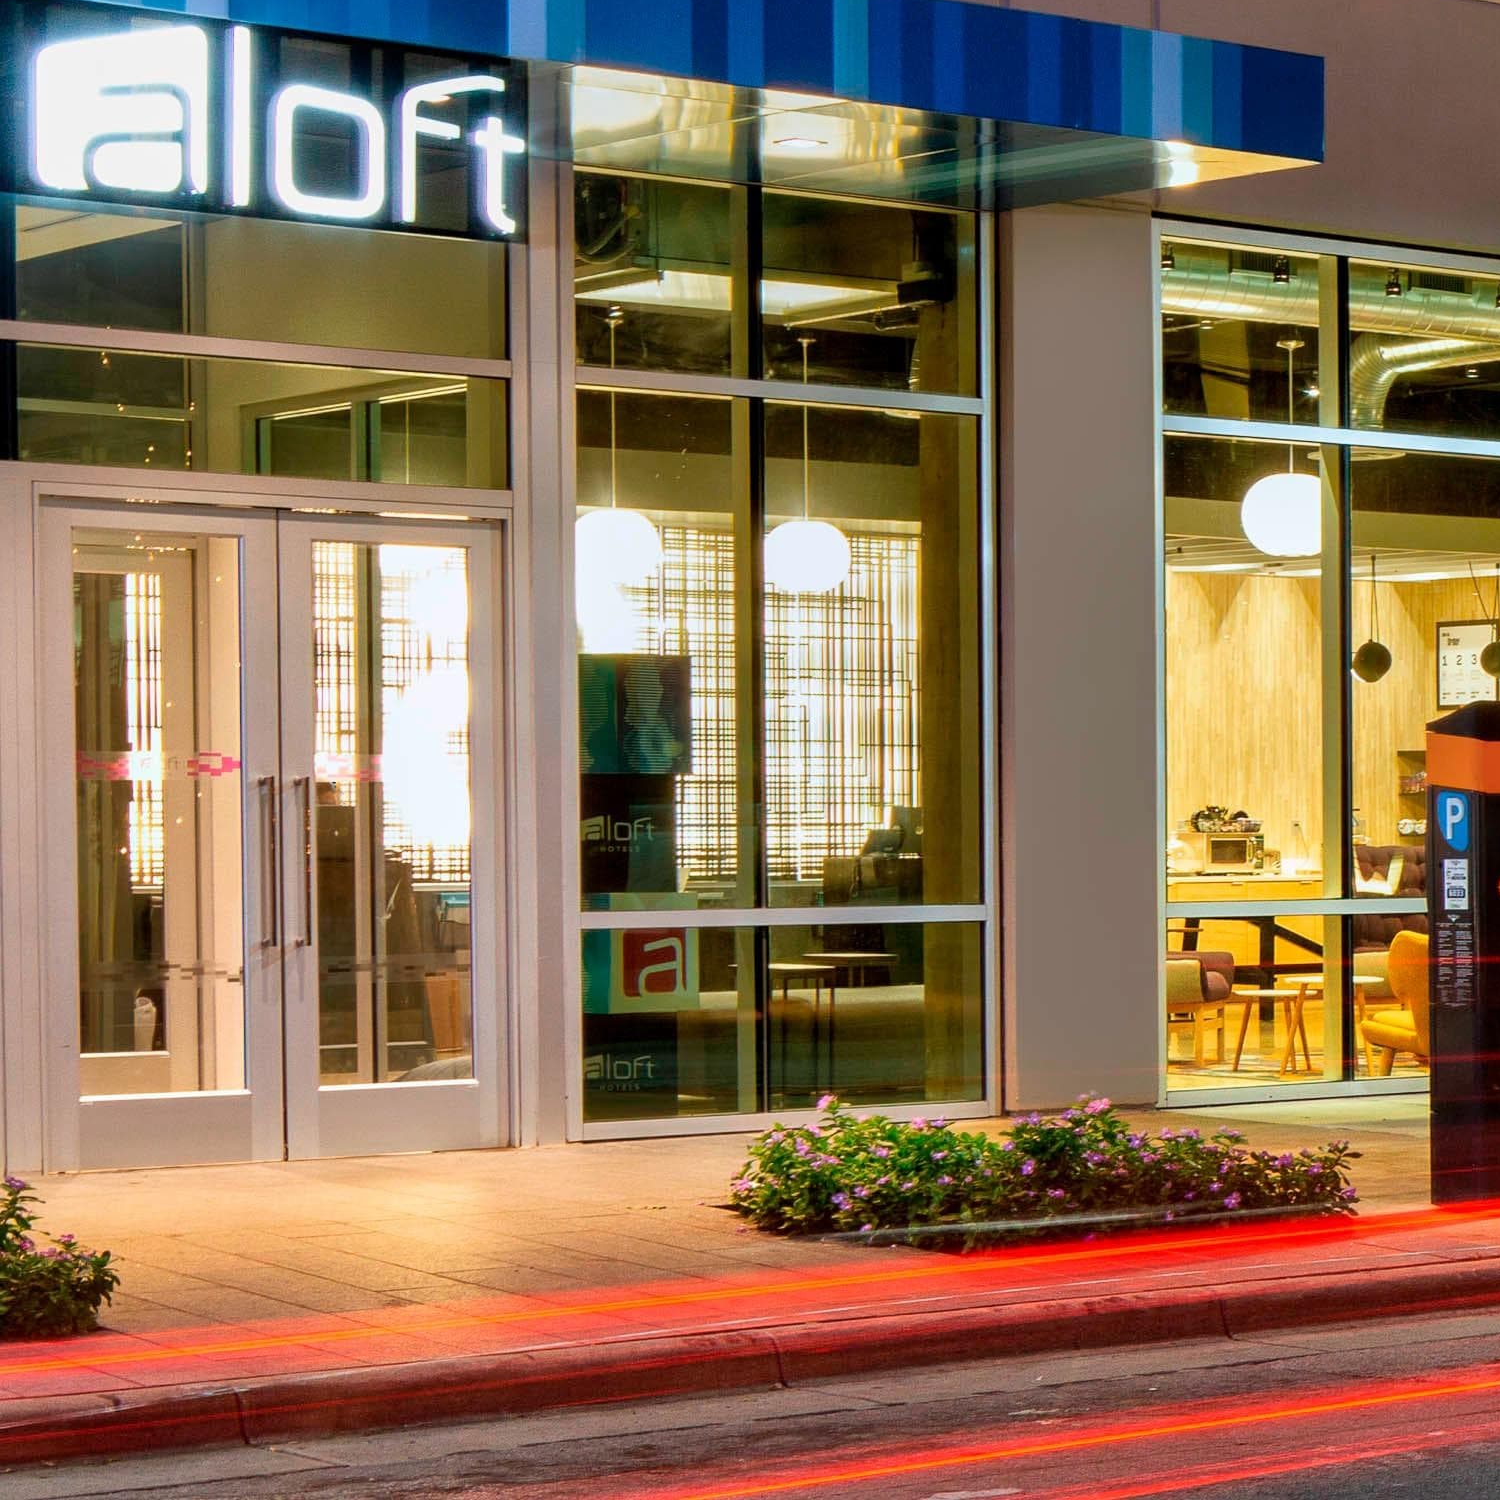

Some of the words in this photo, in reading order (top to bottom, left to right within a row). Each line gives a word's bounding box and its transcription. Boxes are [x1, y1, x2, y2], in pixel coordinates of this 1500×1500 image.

[30, 24, 525, 235] aloft
[581, 814, 656, 842] aloft
[1446, 797, 1465, 840] P
[584, 1053, 657, 1080] aloft
